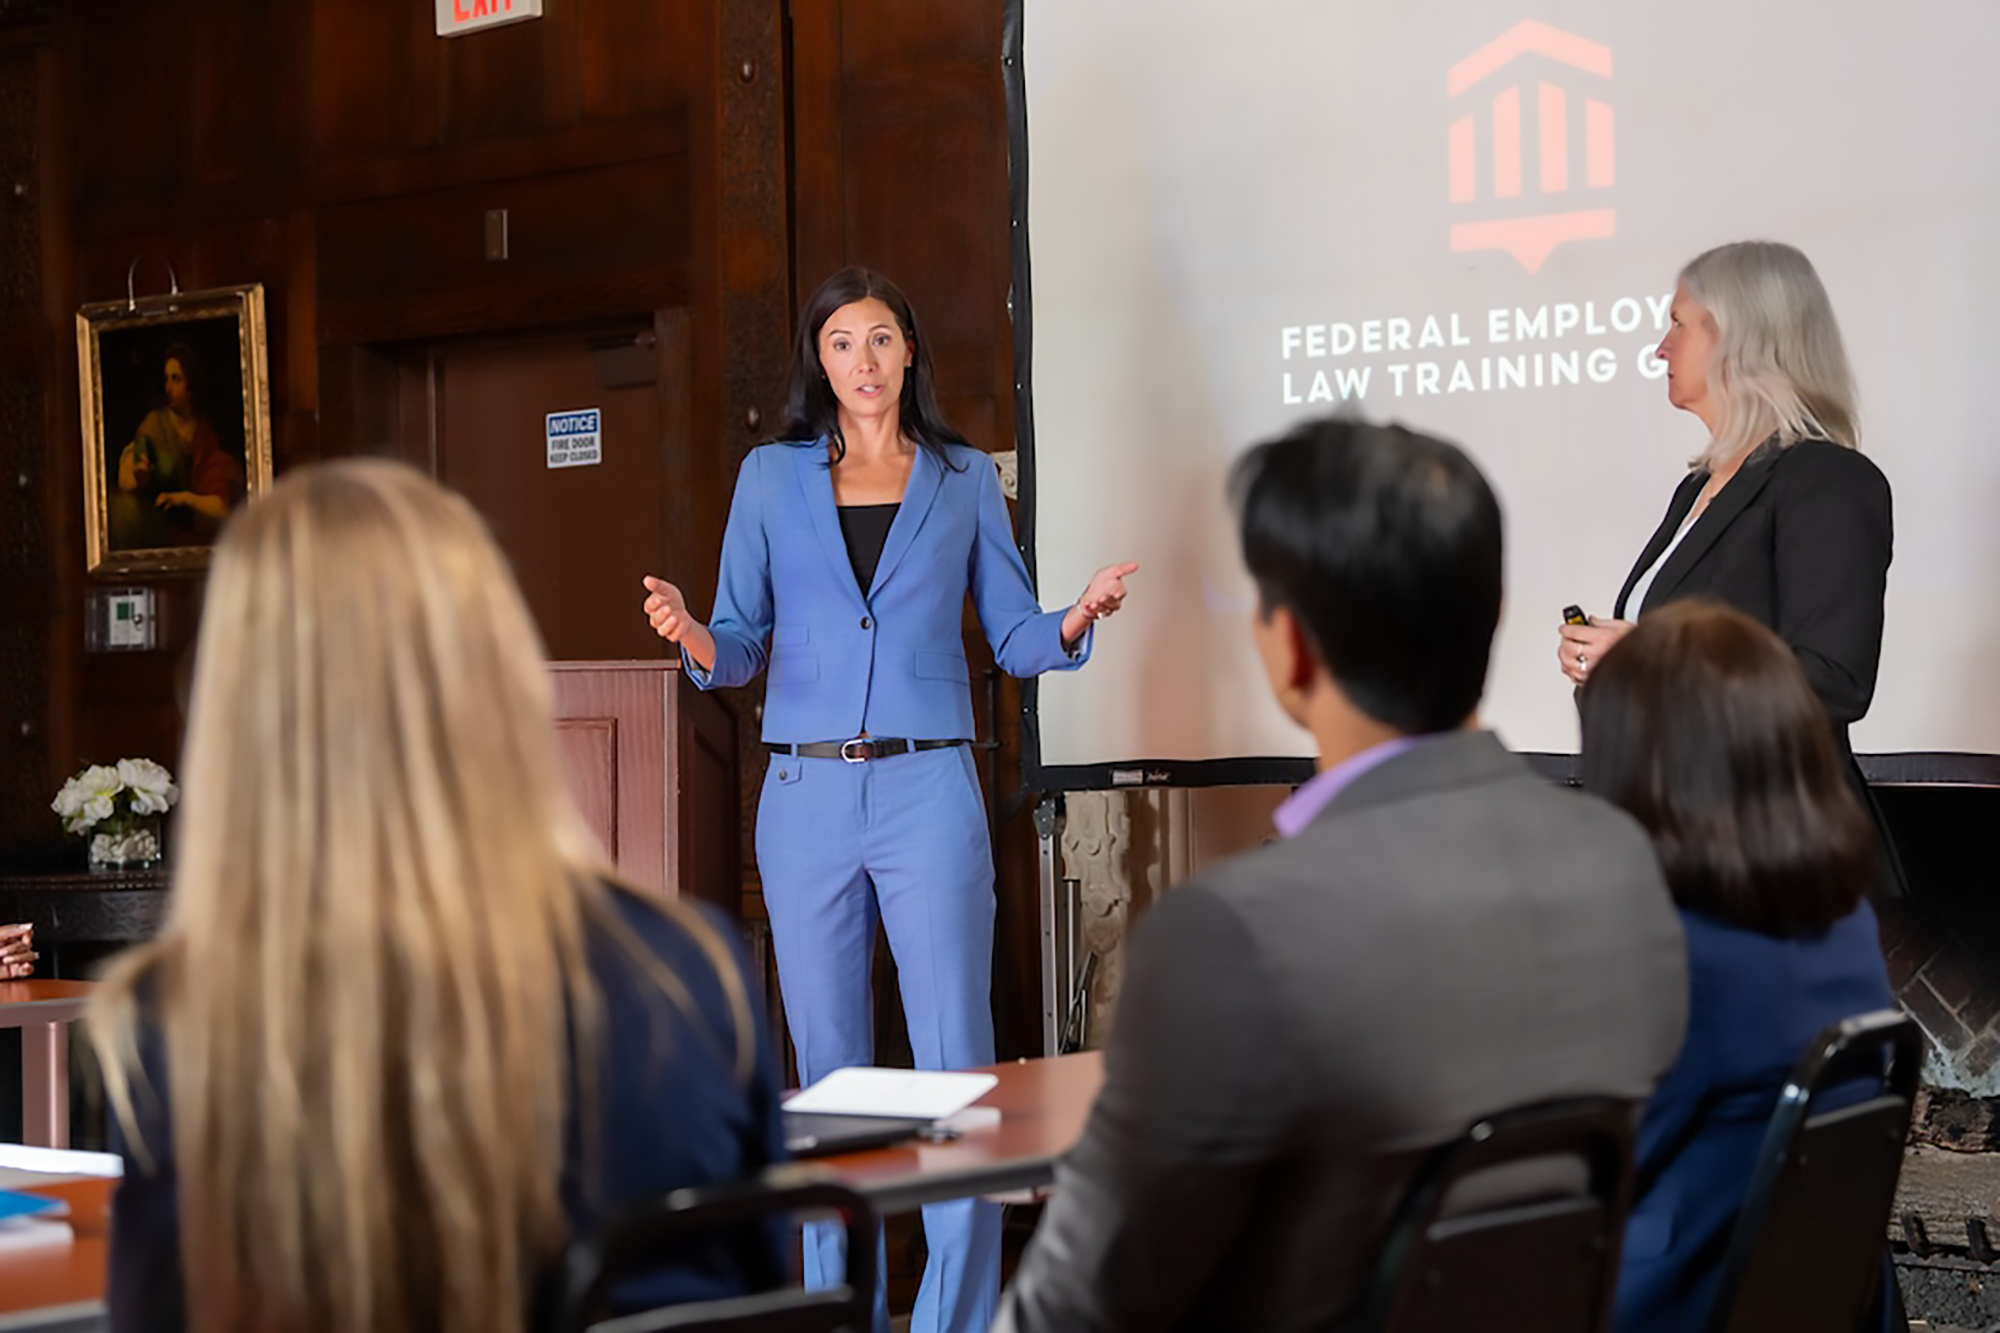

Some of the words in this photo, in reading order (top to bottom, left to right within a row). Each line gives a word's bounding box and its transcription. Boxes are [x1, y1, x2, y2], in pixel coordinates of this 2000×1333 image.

[1282, 313, 1470, 359] FEDERAL
[1283, 366, 1371, 404] LAW
[1387, 347, 1617, 396] TRAINING
[550, 414, 596, 433] NOTICE
[551, 438, 569, 450] FIRE
[572, 435, 595, 449] DOOR
